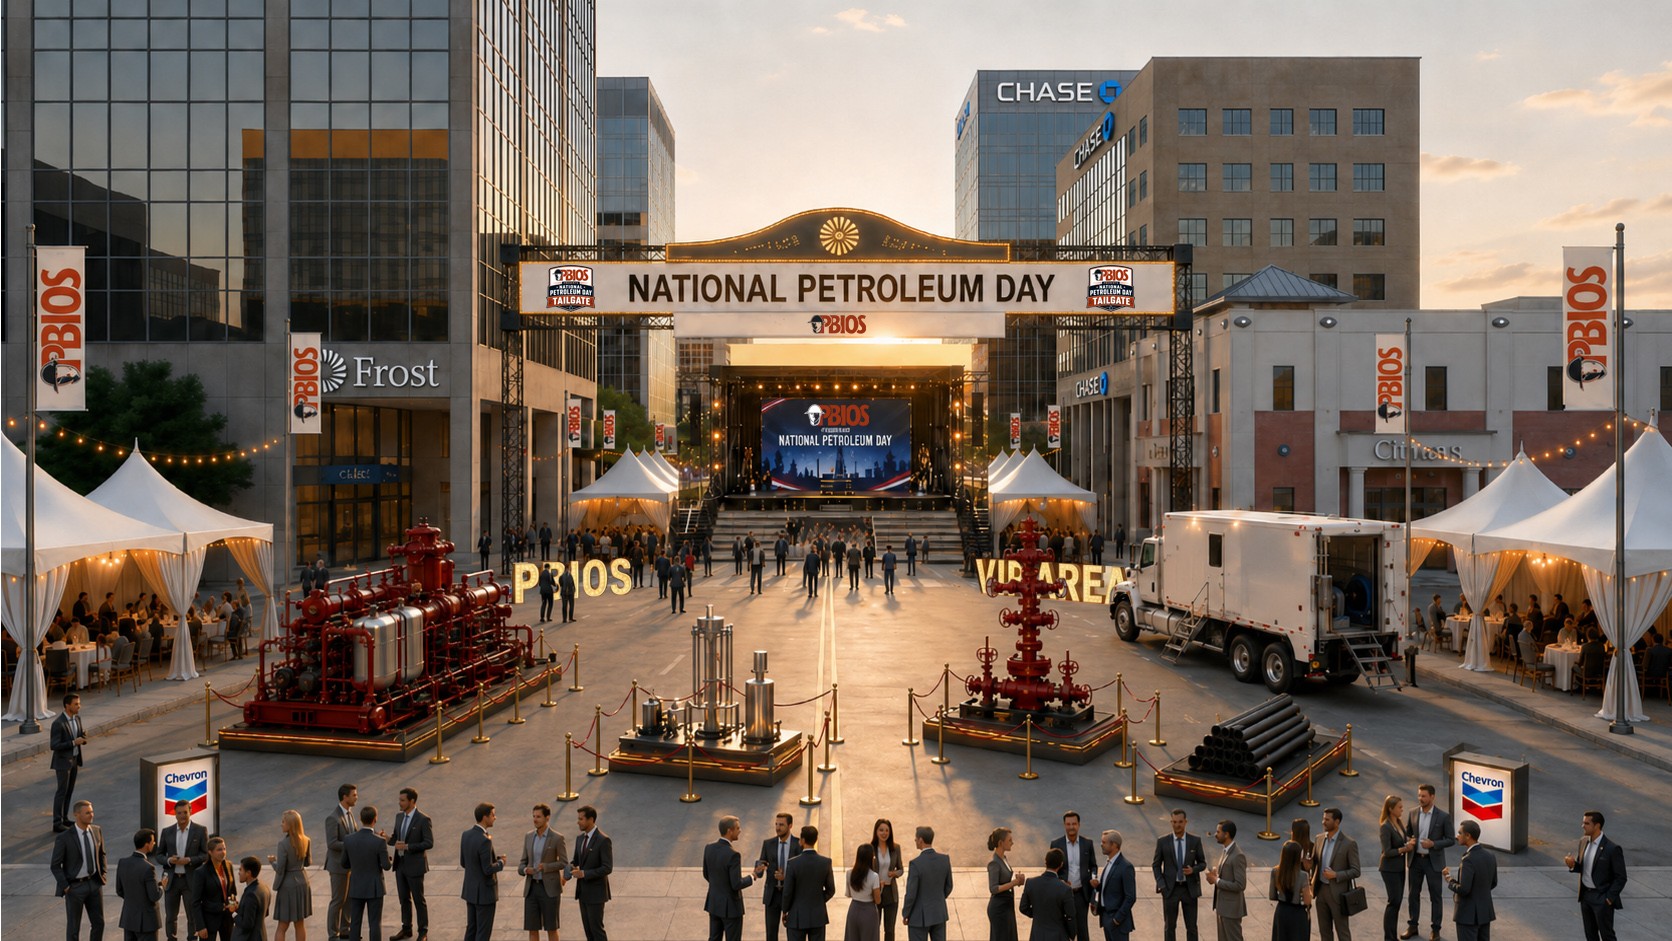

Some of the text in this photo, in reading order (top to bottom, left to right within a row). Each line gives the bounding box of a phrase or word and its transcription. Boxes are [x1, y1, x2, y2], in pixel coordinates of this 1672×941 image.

[997, 82, 1093, 102] CHASE
[1074, 125, 1102, 169] CHASE
[560, 269, 589, 281] PBIOS
[1100, 269, 1129, 281] PBIOS
[629, 274, 1055, 303] NATIONAL PETROLEUM DAY
[553, 296, 591, 306] TAILGATE
[1093, 296, 1131, 306] TAILGATE
[41, 268, 81, 372] PBIOS
[818, 314, 867, 334] PBIOS
[1567, 266, 1607, 367] PBIOS
[293, 347, 318, 411] PBIOS
[353, 356, 440, 388] Frost
[1377, 347, 1403, 410] PBIOS
[1075, 376, 1099, 398] CHASE
[819, 404, 870, 427] PBIOS
[778, 434, 893, 447] NATIONAL PETROLEUM DAY
[165, 770, 207, 784] Chevron
[1461, 771, 1504, 788] Chevron
